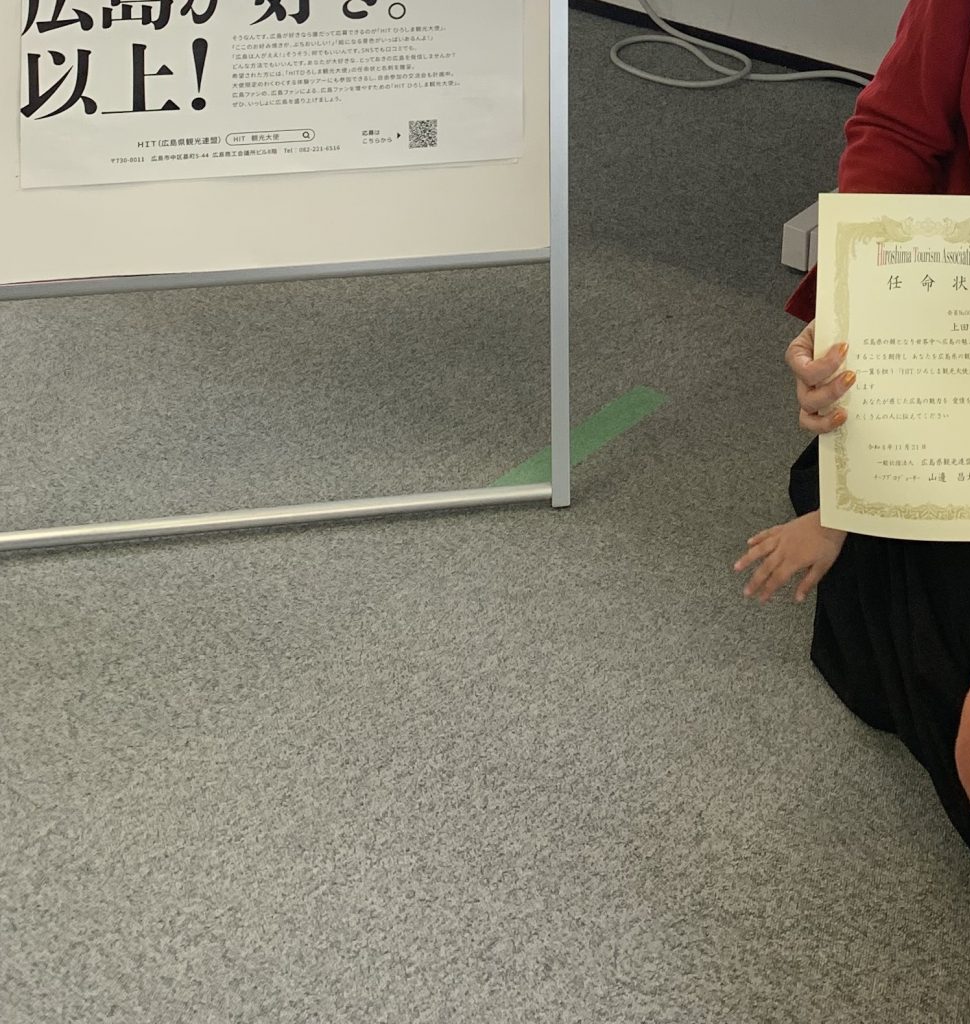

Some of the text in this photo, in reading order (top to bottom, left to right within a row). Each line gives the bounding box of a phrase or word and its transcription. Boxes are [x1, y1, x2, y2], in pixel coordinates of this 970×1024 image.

[233, 133, 280, 143] HIT 観光大使
[363, 136, 393, 145] こちらから
[876, 241, 912, 267] Hiroshima
[913, 246, 941, 263] Tourism
